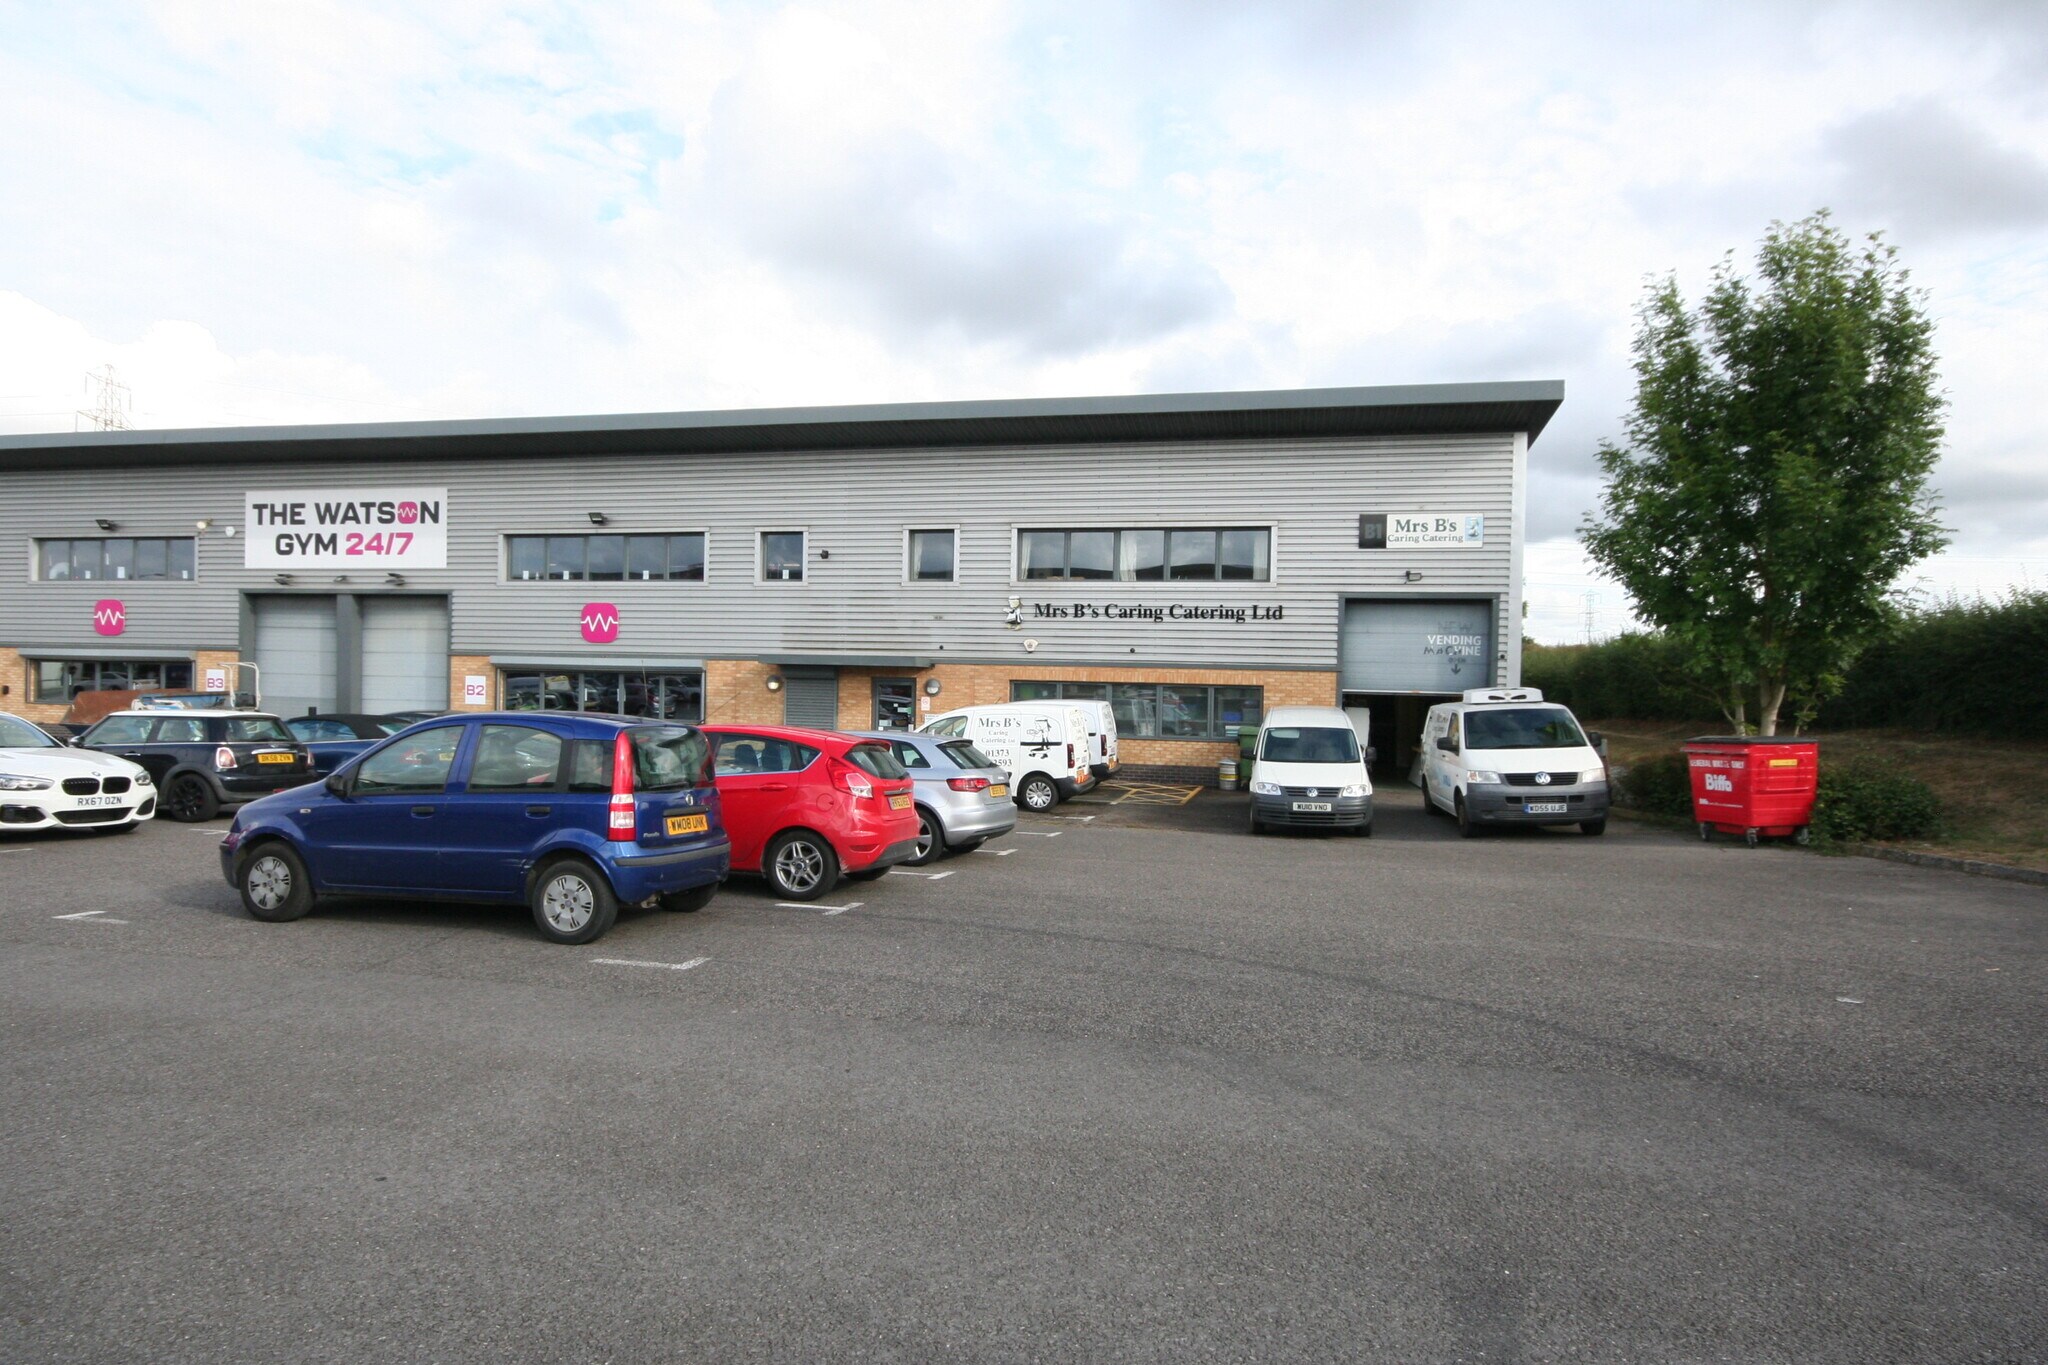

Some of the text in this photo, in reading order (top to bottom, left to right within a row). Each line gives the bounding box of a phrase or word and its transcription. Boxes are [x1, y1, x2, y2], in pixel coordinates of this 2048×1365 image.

[252, 501, 439, 525] THE WATSON
[1395, 518, 1457, 532] Mrs B's
[1364, 524, 1382, 539] B1
[275, 532, 414, 555] GYM 24/7
[1387, 534, 1463, 543] Caring Catering
[1034, 603, 1068, 618] Mrs
[1104, 604, 1163, 622] Caring
[1169, 604, 1246, 623] Catering
[1251, 605, 1283, 620] Ltd
[1427, 634, 1482, 645] VENDING
[207, 678, 224, 688] B3
[466, 684, 485, 695] B2
[978, 717, 1001, 728] Mrs
[985, 749, 1010, 757] 01373
[1704, 773, 1732, 792] Biffa
[77, 796, 122, 806] RX67 OZN
[1551, 804, 1566, 812] UJE
[670, 818, 691, 832] WM08
